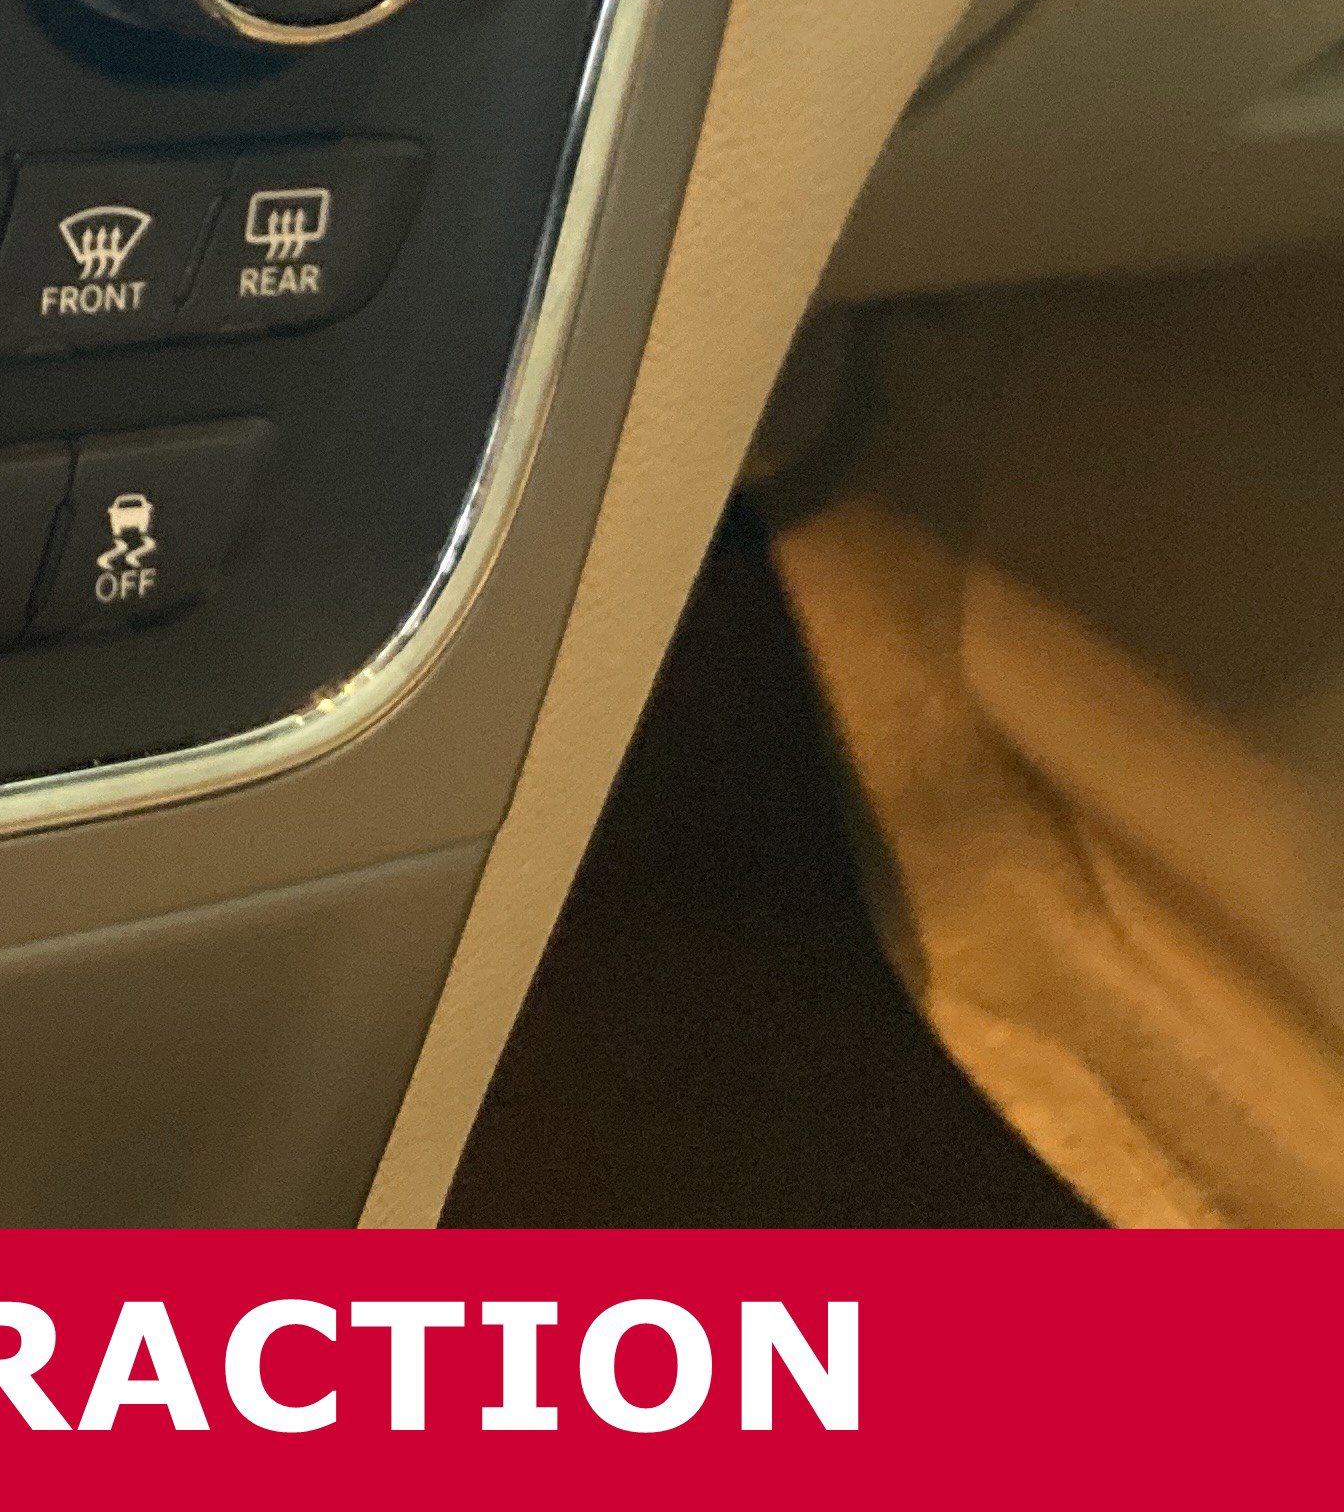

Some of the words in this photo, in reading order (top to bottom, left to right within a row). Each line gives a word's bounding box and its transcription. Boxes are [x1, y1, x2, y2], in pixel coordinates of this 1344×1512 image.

[239, 264, 322, 298] REAR
[41, 282, 147, 316] FRONT
[95, 567, 158, 604] OFF
